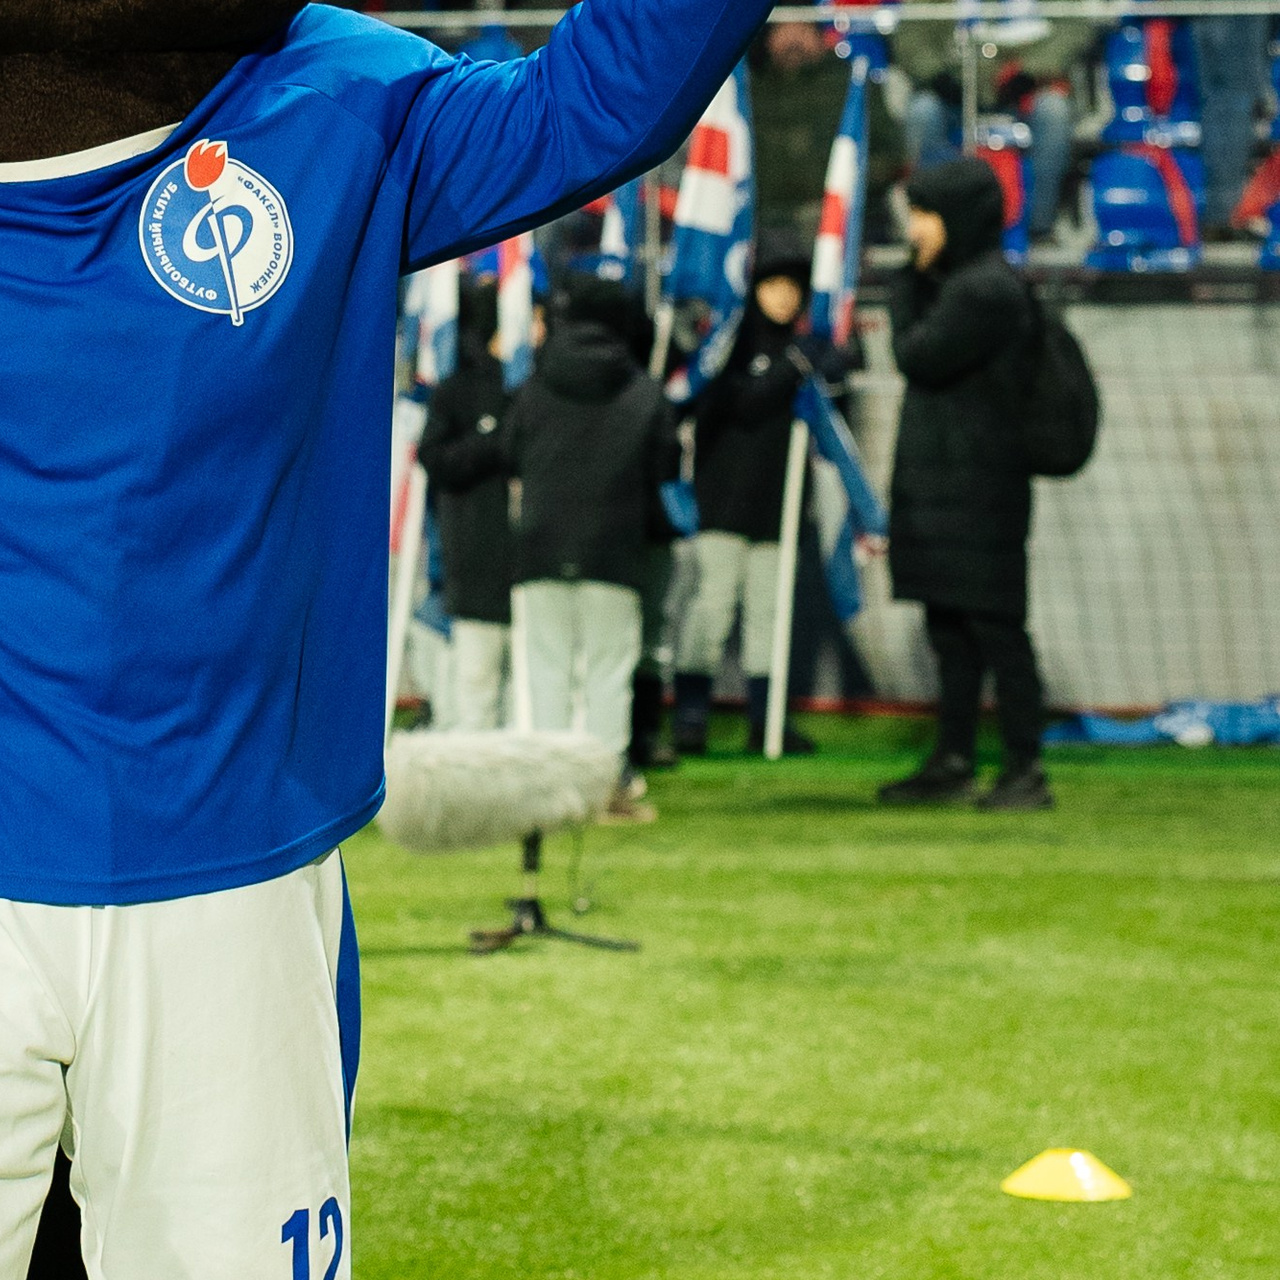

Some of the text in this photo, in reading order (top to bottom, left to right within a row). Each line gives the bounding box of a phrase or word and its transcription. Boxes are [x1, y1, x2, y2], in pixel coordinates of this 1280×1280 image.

[148, 181, 218, 301] ФУТБОЛЬНЫЙ КЛУБ
[237, 175, 283, 294] «ФАКЕЛ» ВОРОНЕЖ
